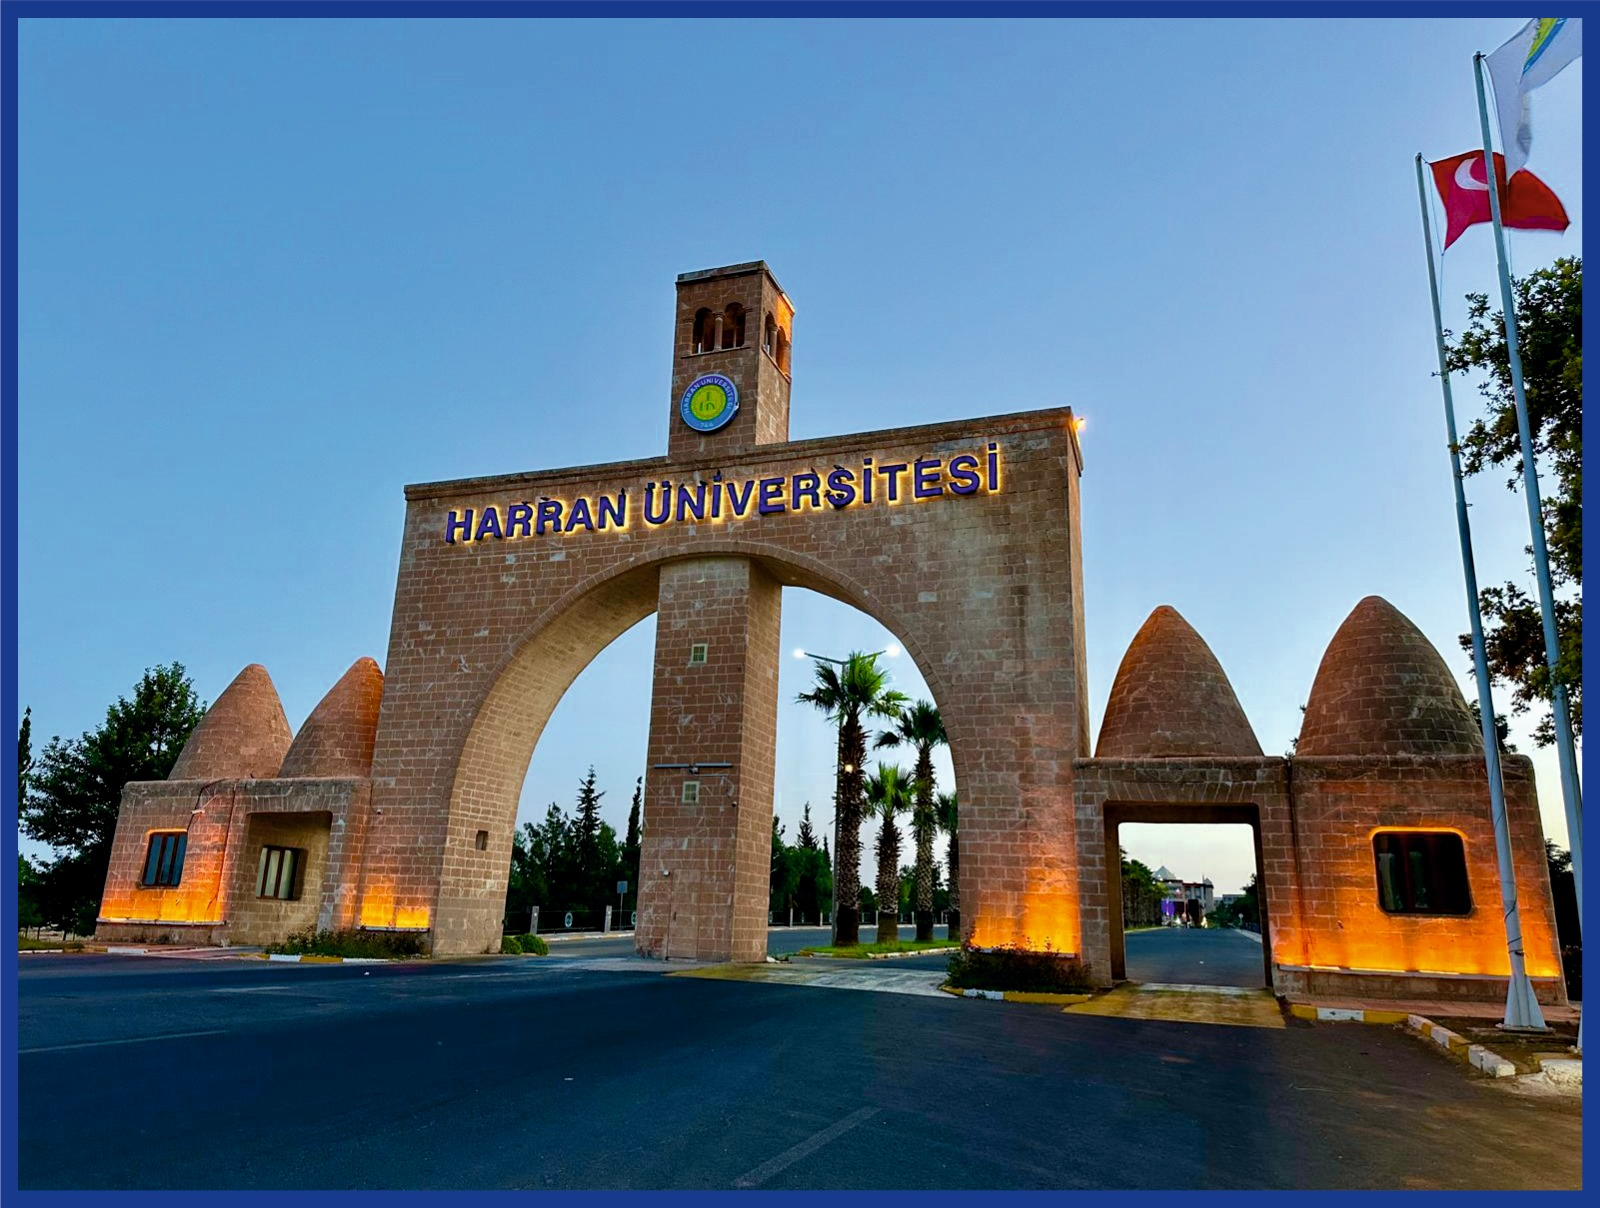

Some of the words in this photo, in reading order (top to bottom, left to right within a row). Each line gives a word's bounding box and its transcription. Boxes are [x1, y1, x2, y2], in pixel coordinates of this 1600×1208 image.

[683, 383, 700, 414] HARRAN
[445, 494, 627, 543] HARRAN
[644, 442, 998, 525] ÜNİVERSİTESİ
